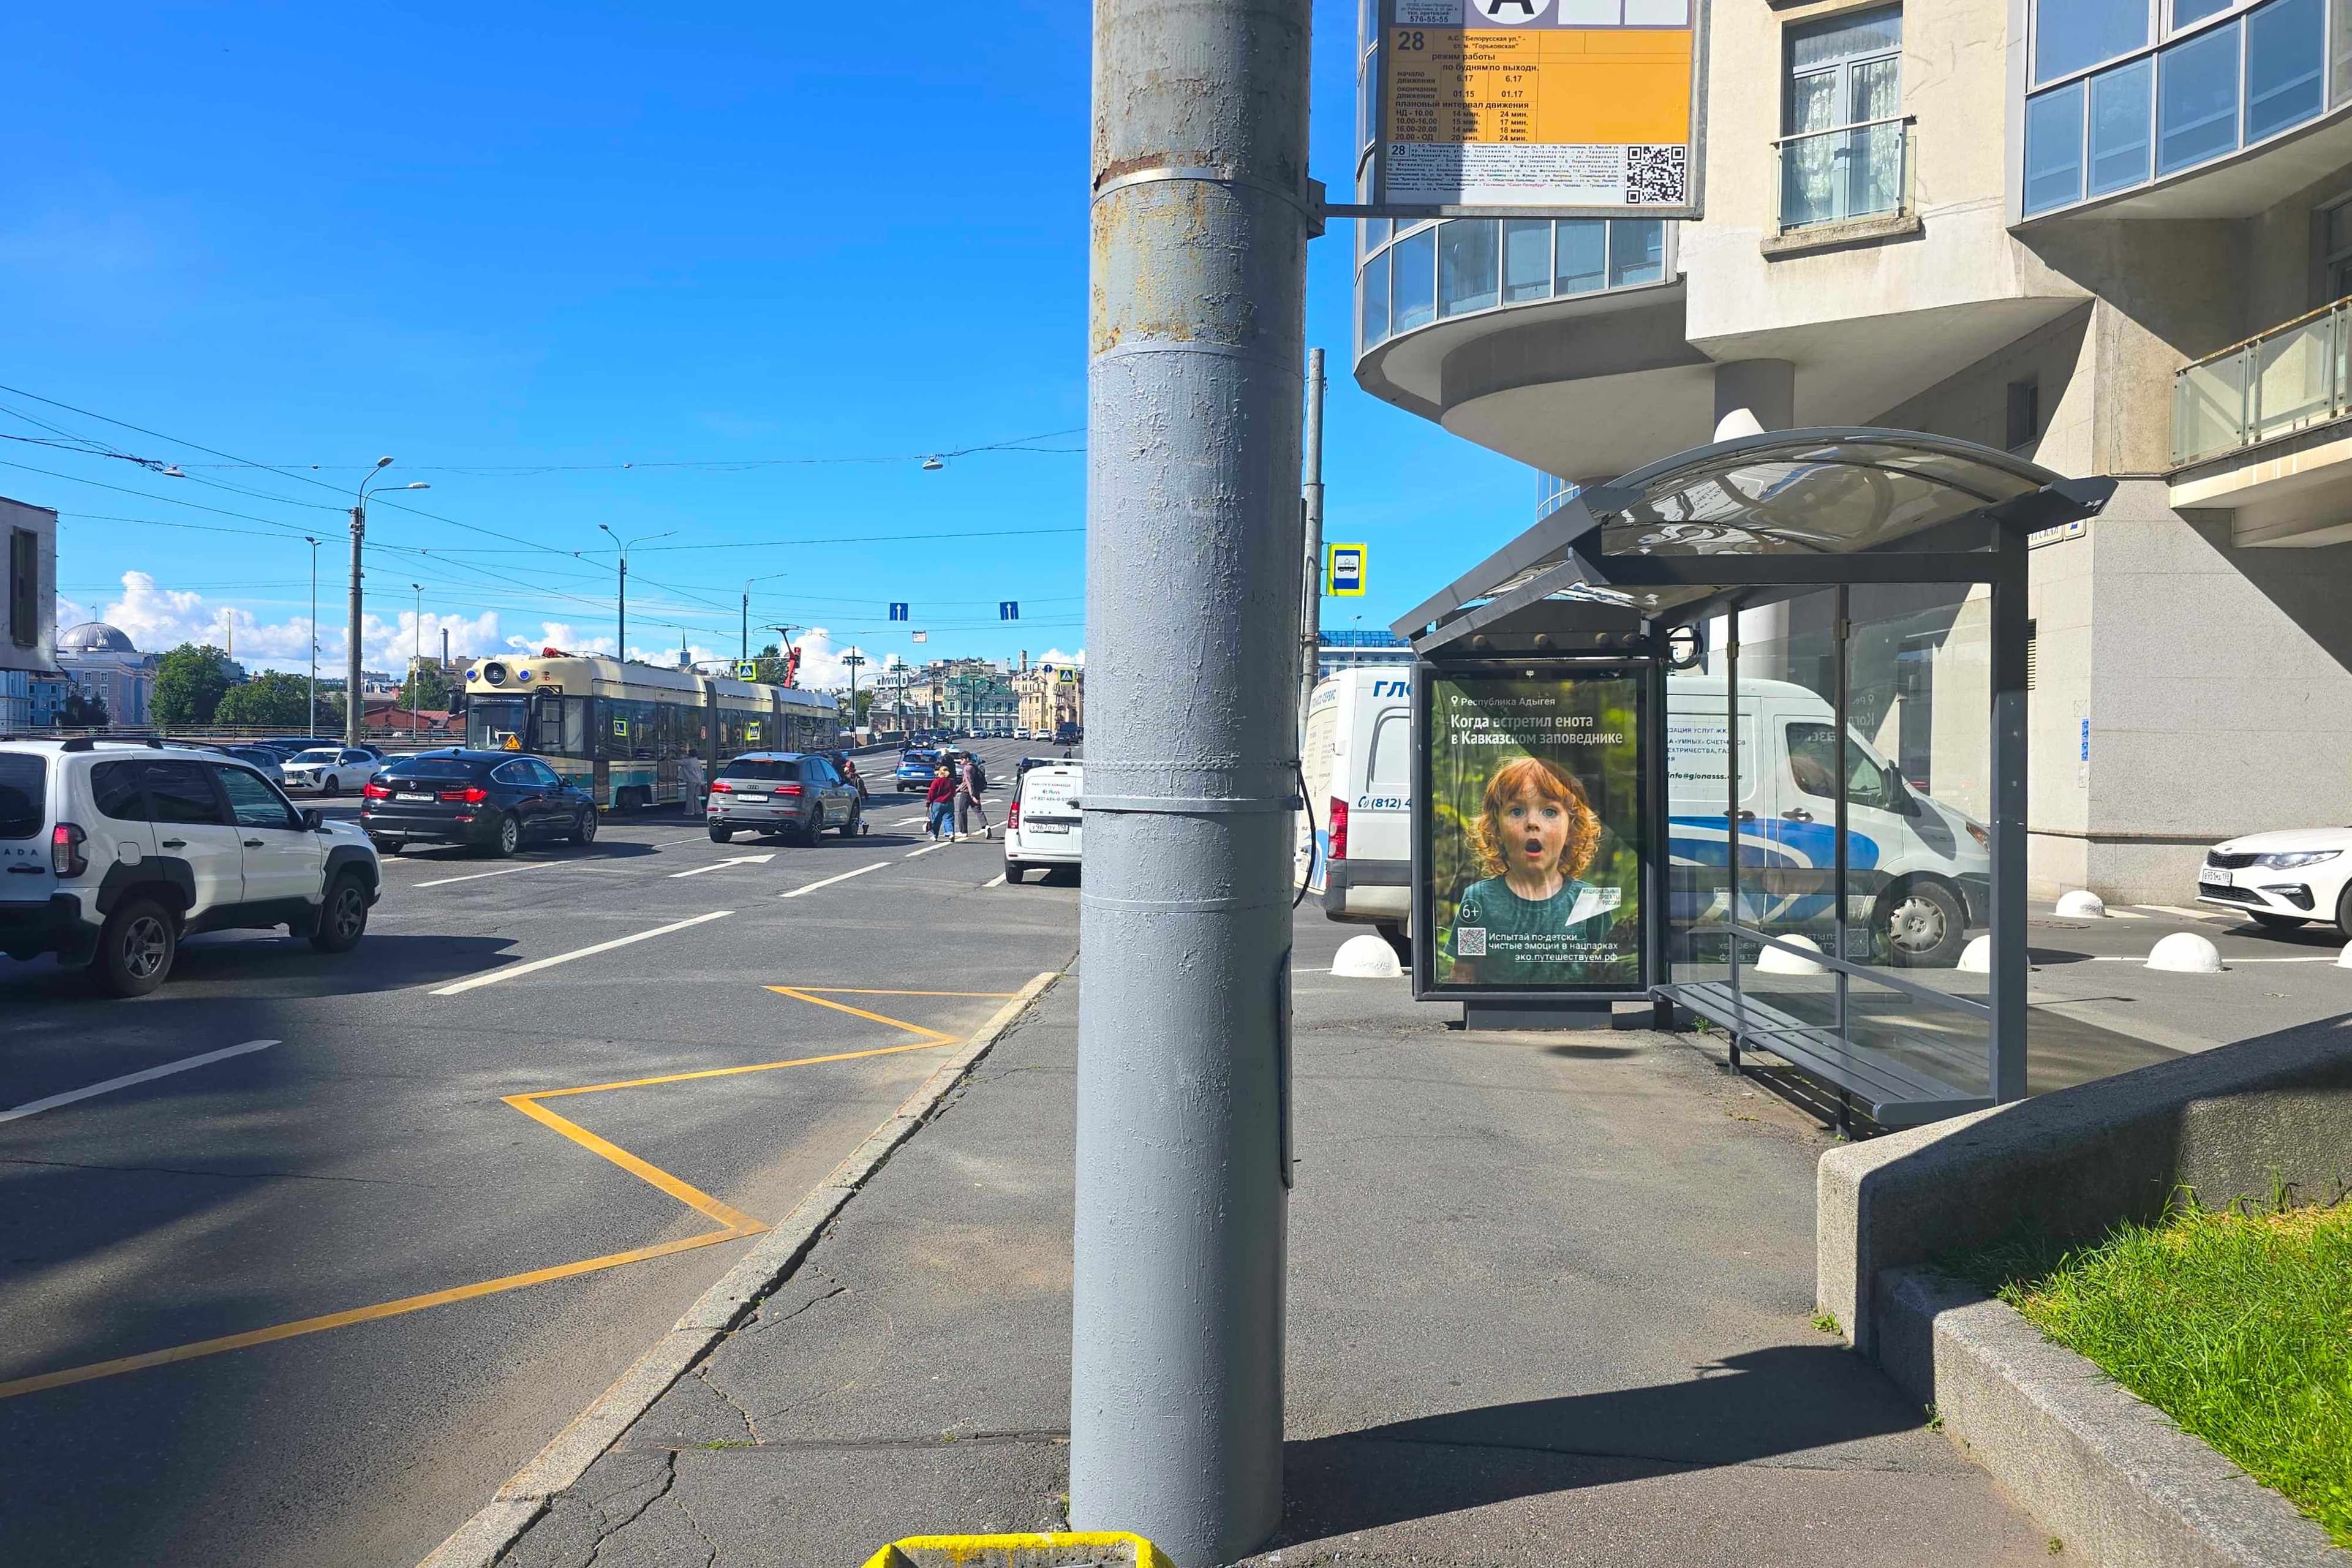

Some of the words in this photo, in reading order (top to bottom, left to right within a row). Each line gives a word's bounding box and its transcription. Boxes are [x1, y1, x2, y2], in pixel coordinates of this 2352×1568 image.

[1398, 31, 1425, 51] 28
[1463, 53, 1495, 61] работы
[1456, 64, 1488, 73] будням
[1392, 145, 1405, 155] 28
[1461, 697, 1517, 706] Республика
[1518, 698, 1556, 706] Адыгея
[1450, 714, 1490, 729] Когда
[1493, 717, 1551, 730] встретил
[1555, 717, 1593, 727] енота
[1450, 734, 1458, 744] в
[1461, 731, 1536, 744] Кавказском
[1539, 733, 1623, 747] заповеднике
[1371, 798, 1401, 810] (812)
[1462, 904, 1479, 918] 6+
[1489, 932, 1529, 941] Испытай
[1532, 933, 1578, 942] по-детски
[1515, 953, 1618, 962] эко.путешествуем.рф
